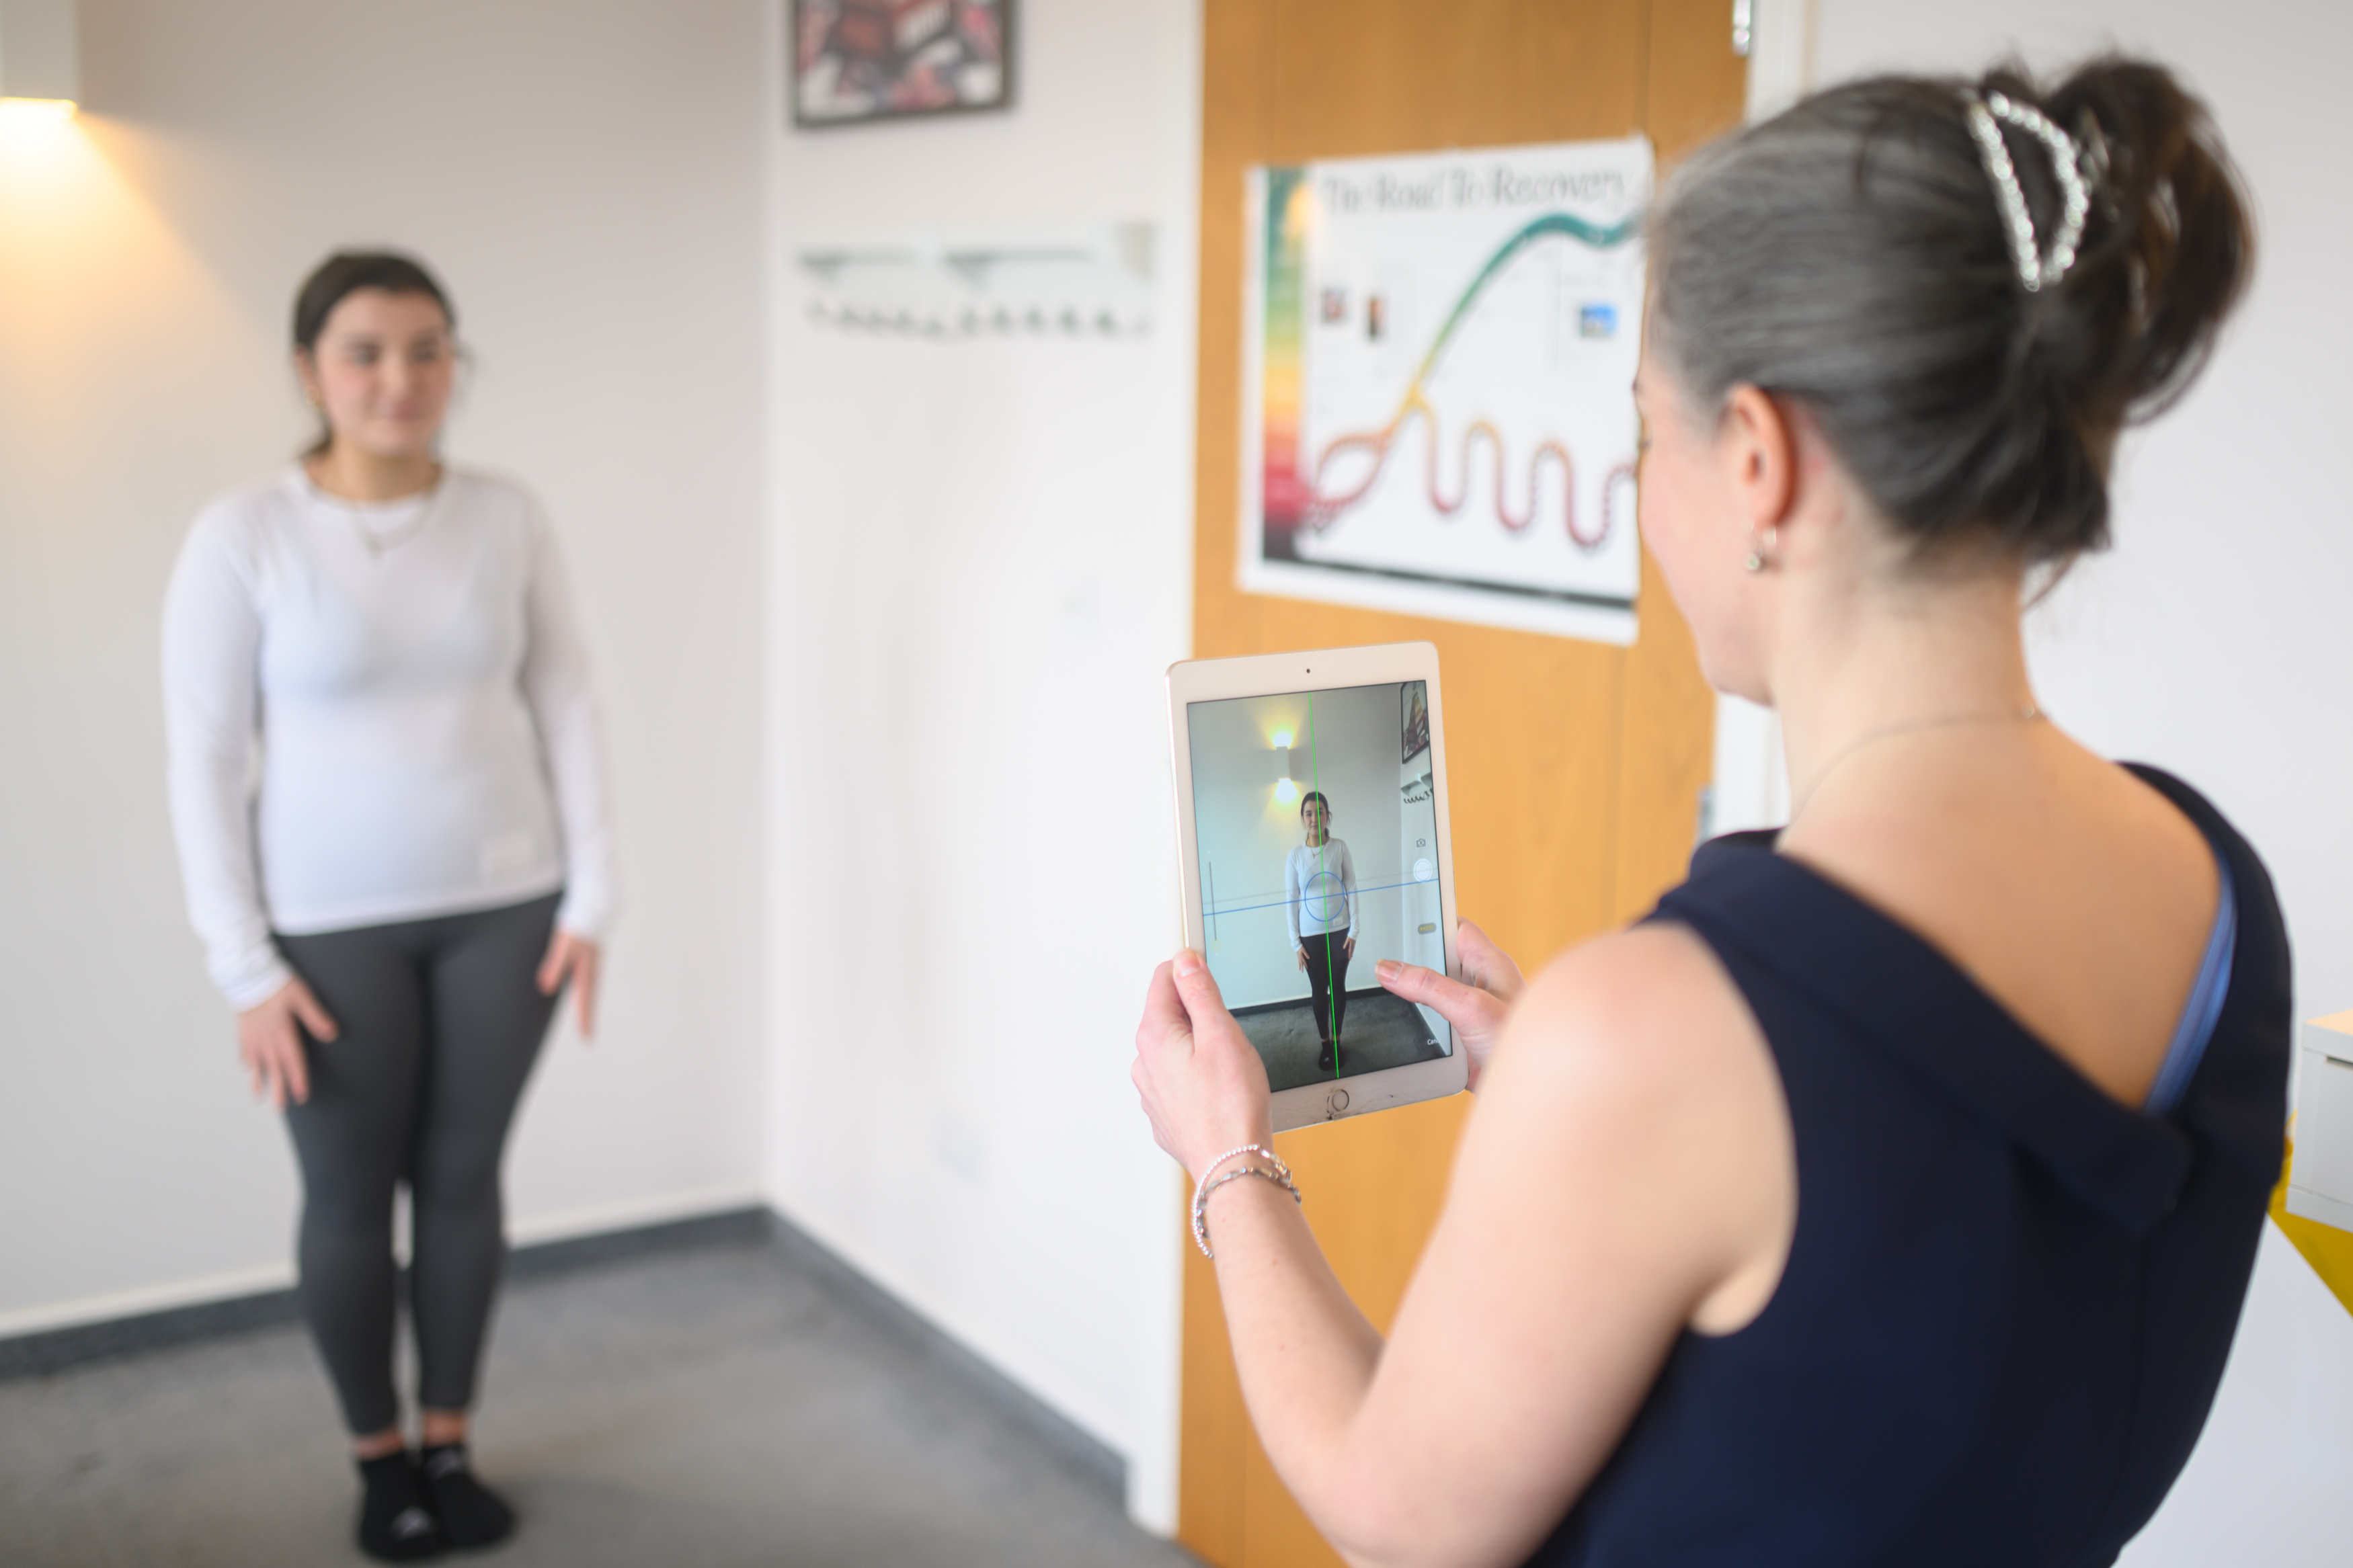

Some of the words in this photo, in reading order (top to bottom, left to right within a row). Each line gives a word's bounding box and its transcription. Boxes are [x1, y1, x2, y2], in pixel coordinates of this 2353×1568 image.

[1324, 173, 1370, 212] The
[1377, 170, 1443, 210] Road
[1448, 166, 1483, 209] To
[1489, 163, 1630, 213] Recovery
